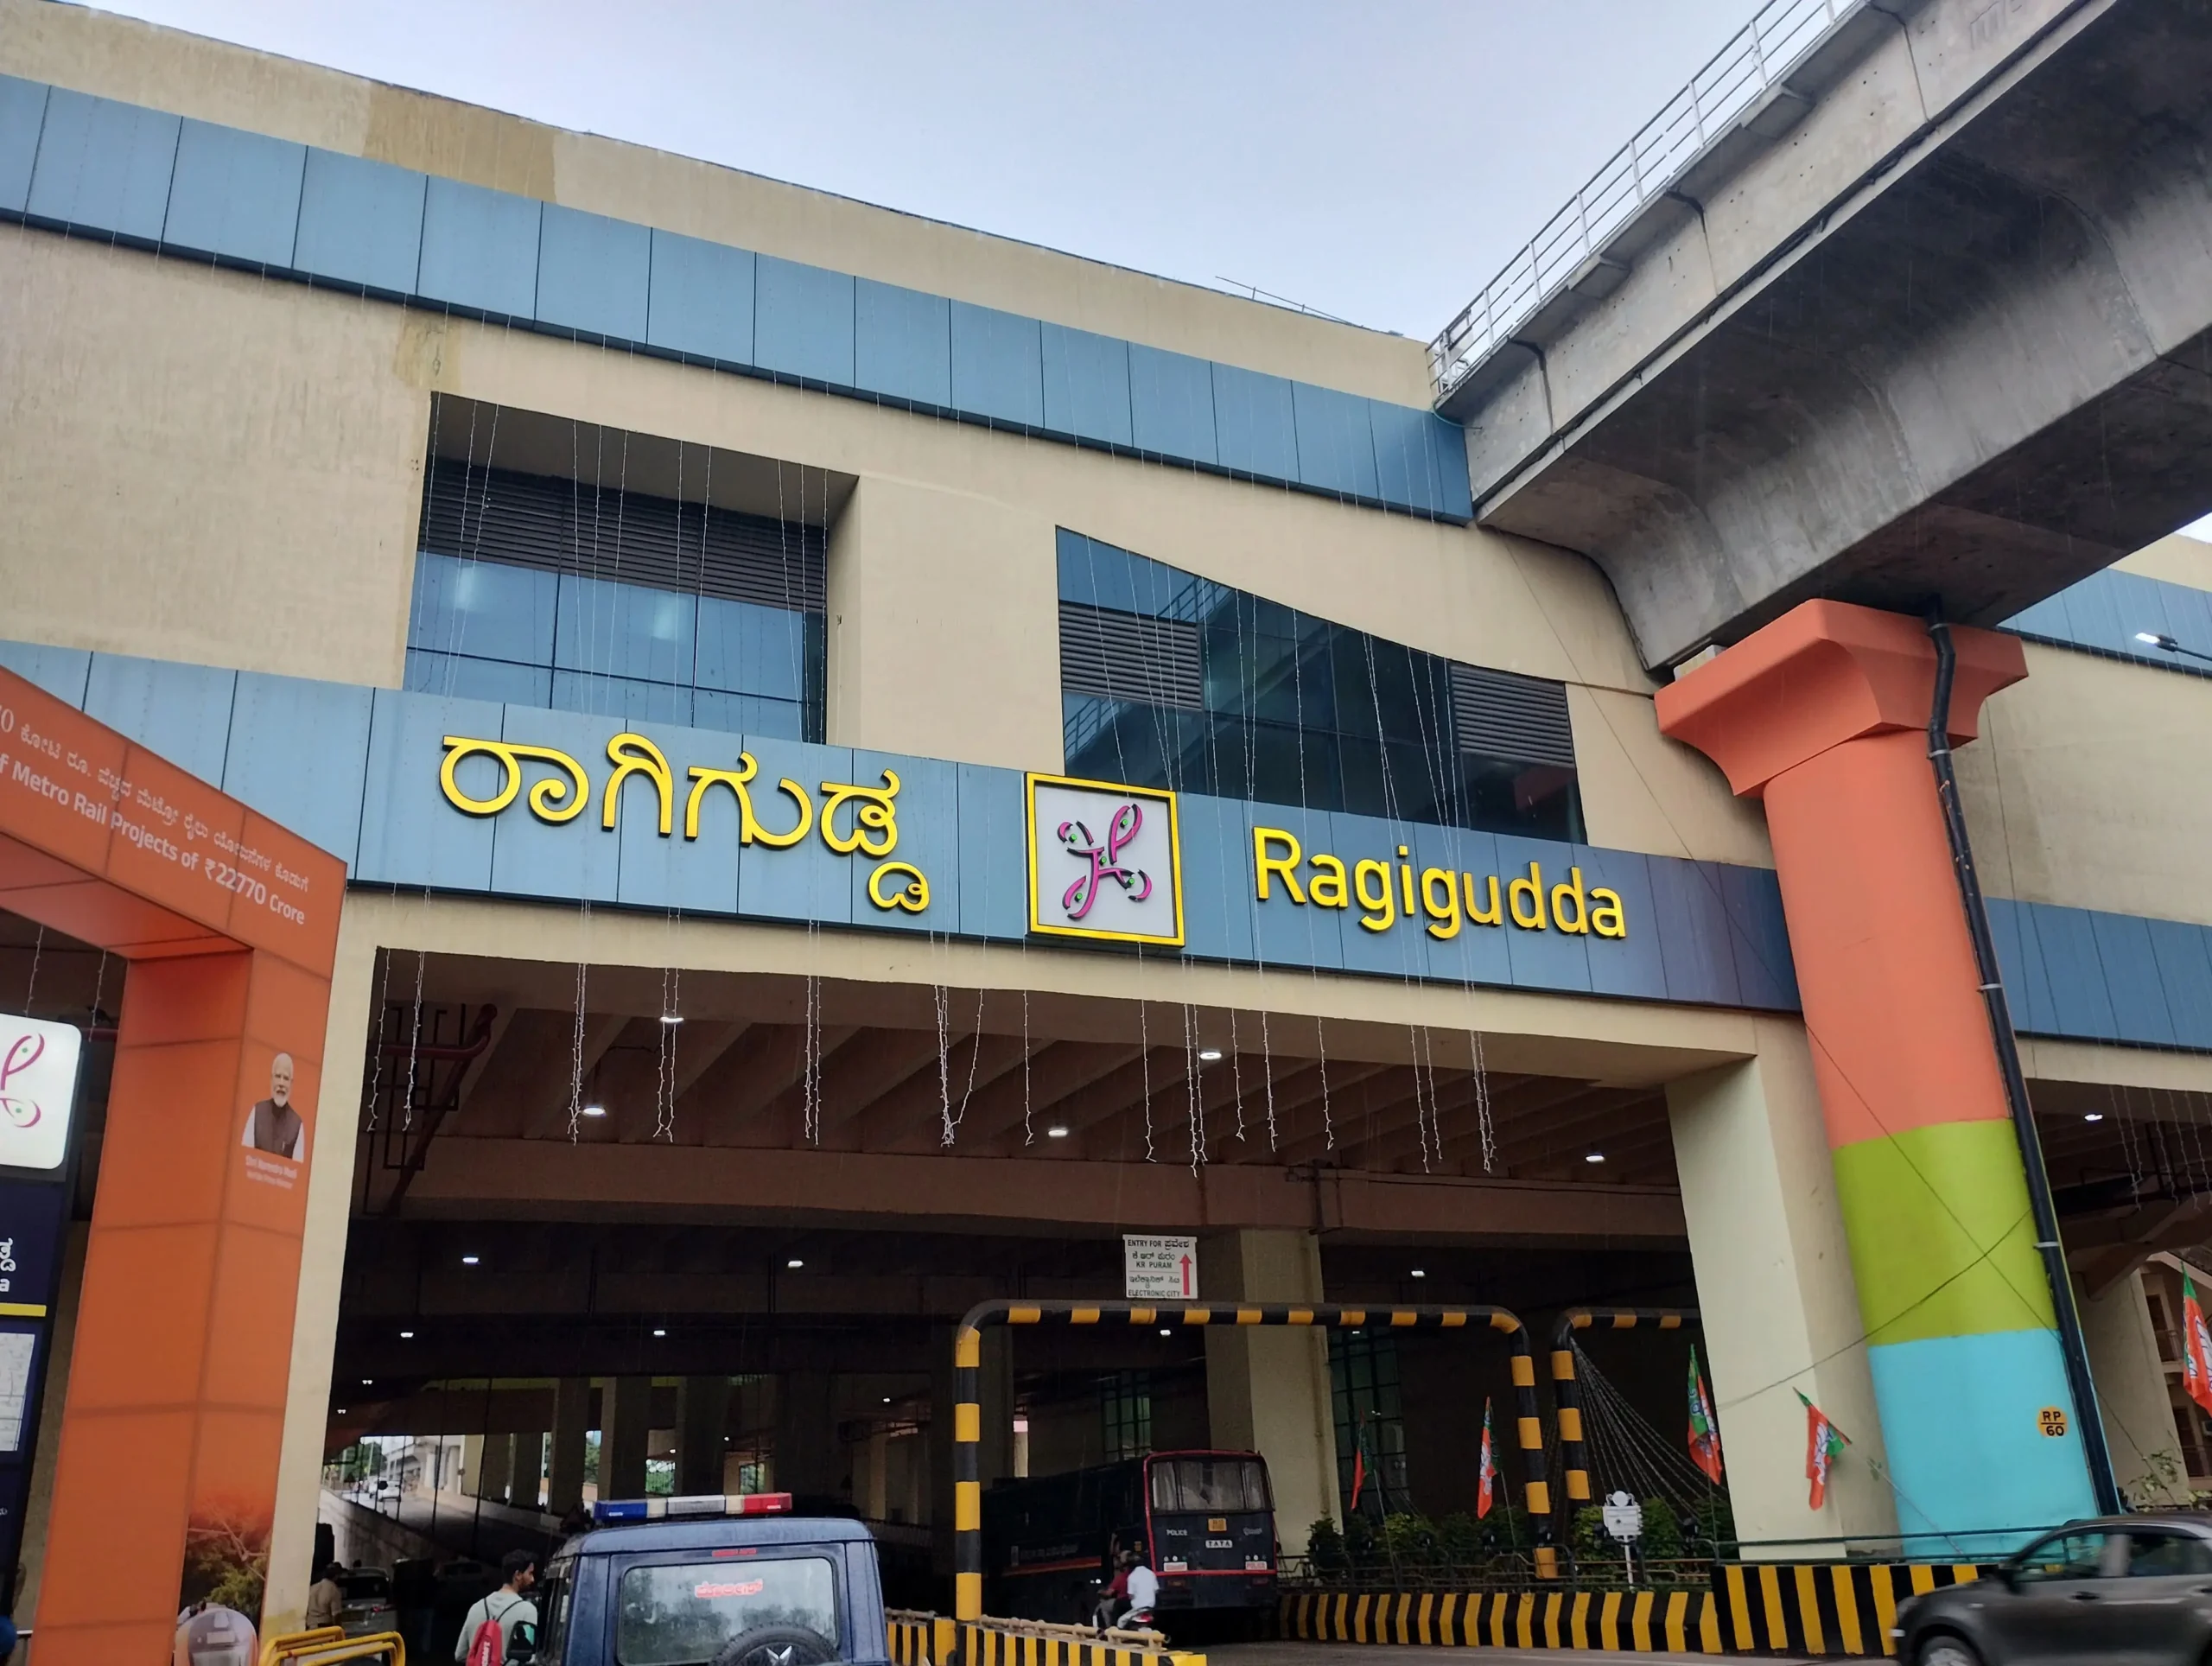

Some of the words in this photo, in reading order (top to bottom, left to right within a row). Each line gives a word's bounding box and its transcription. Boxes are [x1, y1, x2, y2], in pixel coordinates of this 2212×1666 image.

[12, 760, 69, 805] Metro
[74, 792, 107, 824] Rail
[111, 811, 178, 861] Projects
[181, 852, 199, 870] of
[204, 857, 266, 905] ₹22770
[270, 893, 305, 925] Crore
[439, 733, 931, 913] ರಾಗಿಗುಡ್ಡ
[1253, 826, 1627, 939] Ragigudda
[2046, 1425, 2064, 1436] 60
